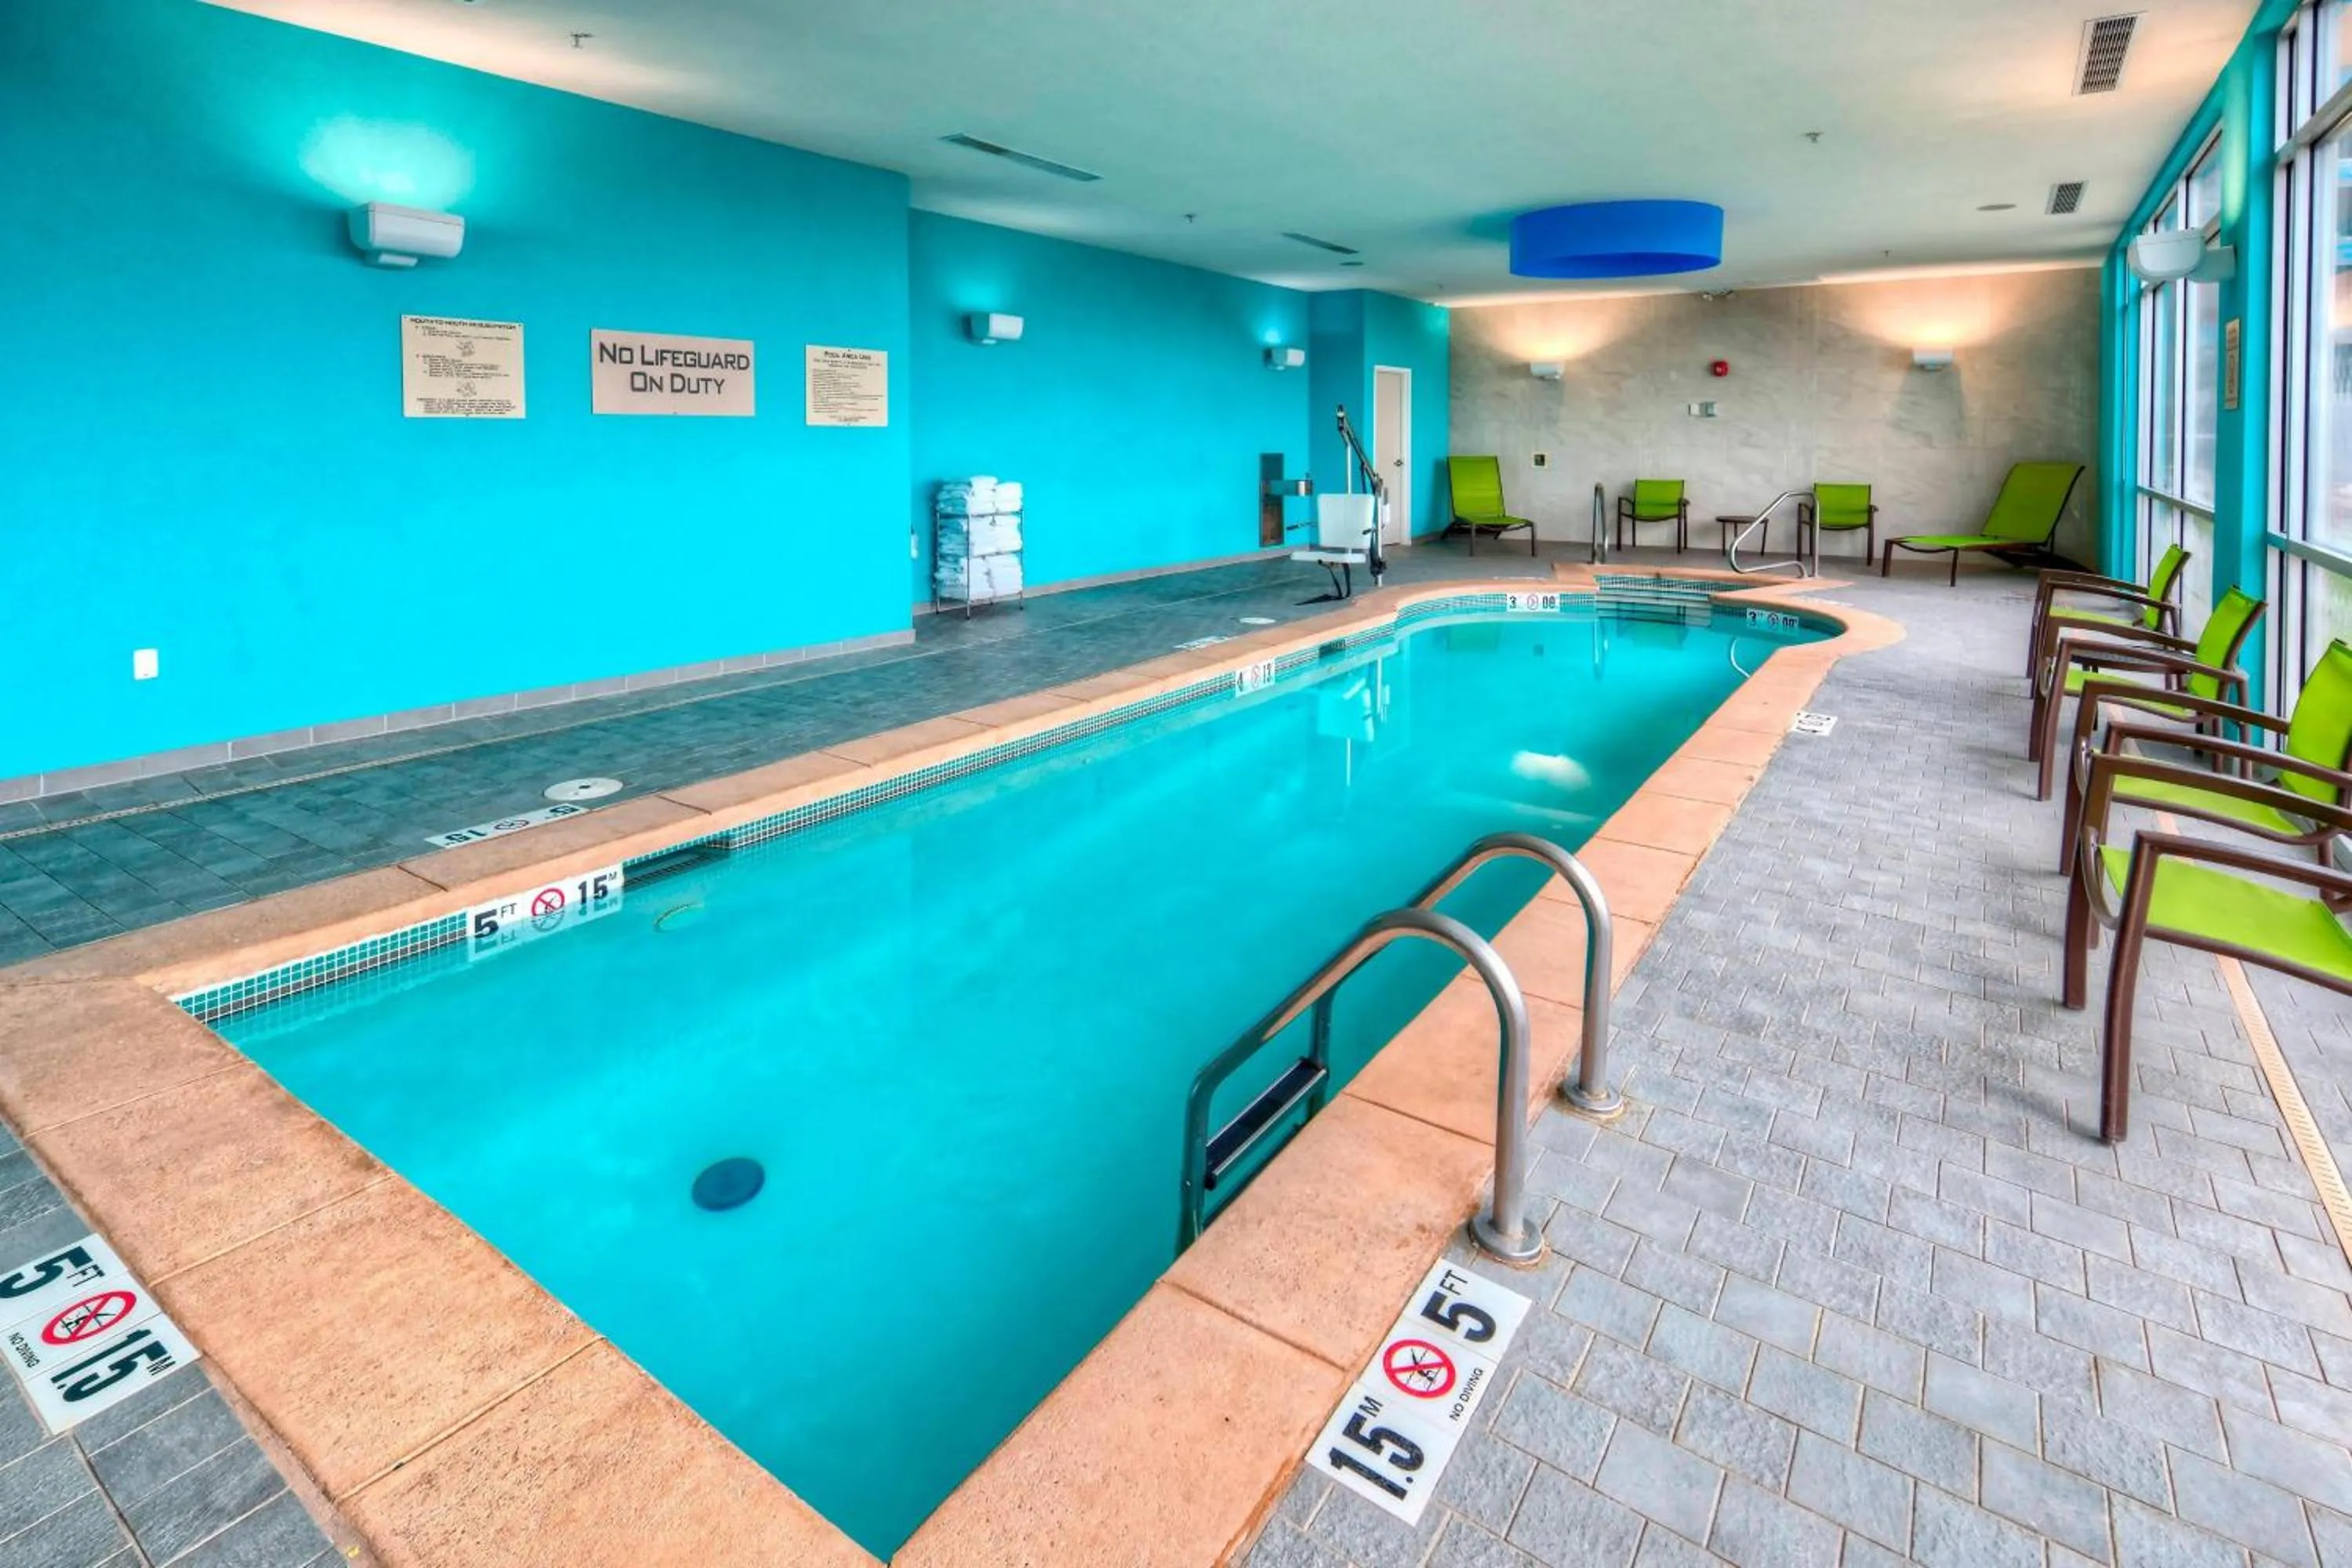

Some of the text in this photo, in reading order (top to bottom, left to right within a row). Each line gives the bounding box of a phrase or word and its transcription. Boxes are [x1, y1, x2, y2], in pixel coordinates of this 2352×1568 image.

[599, 342, 750, 370] NO LIFEGUARD
[630, 371, 724, 394] ON DUTY
[1449, 1367, 1483, 1421] NO DIVING
